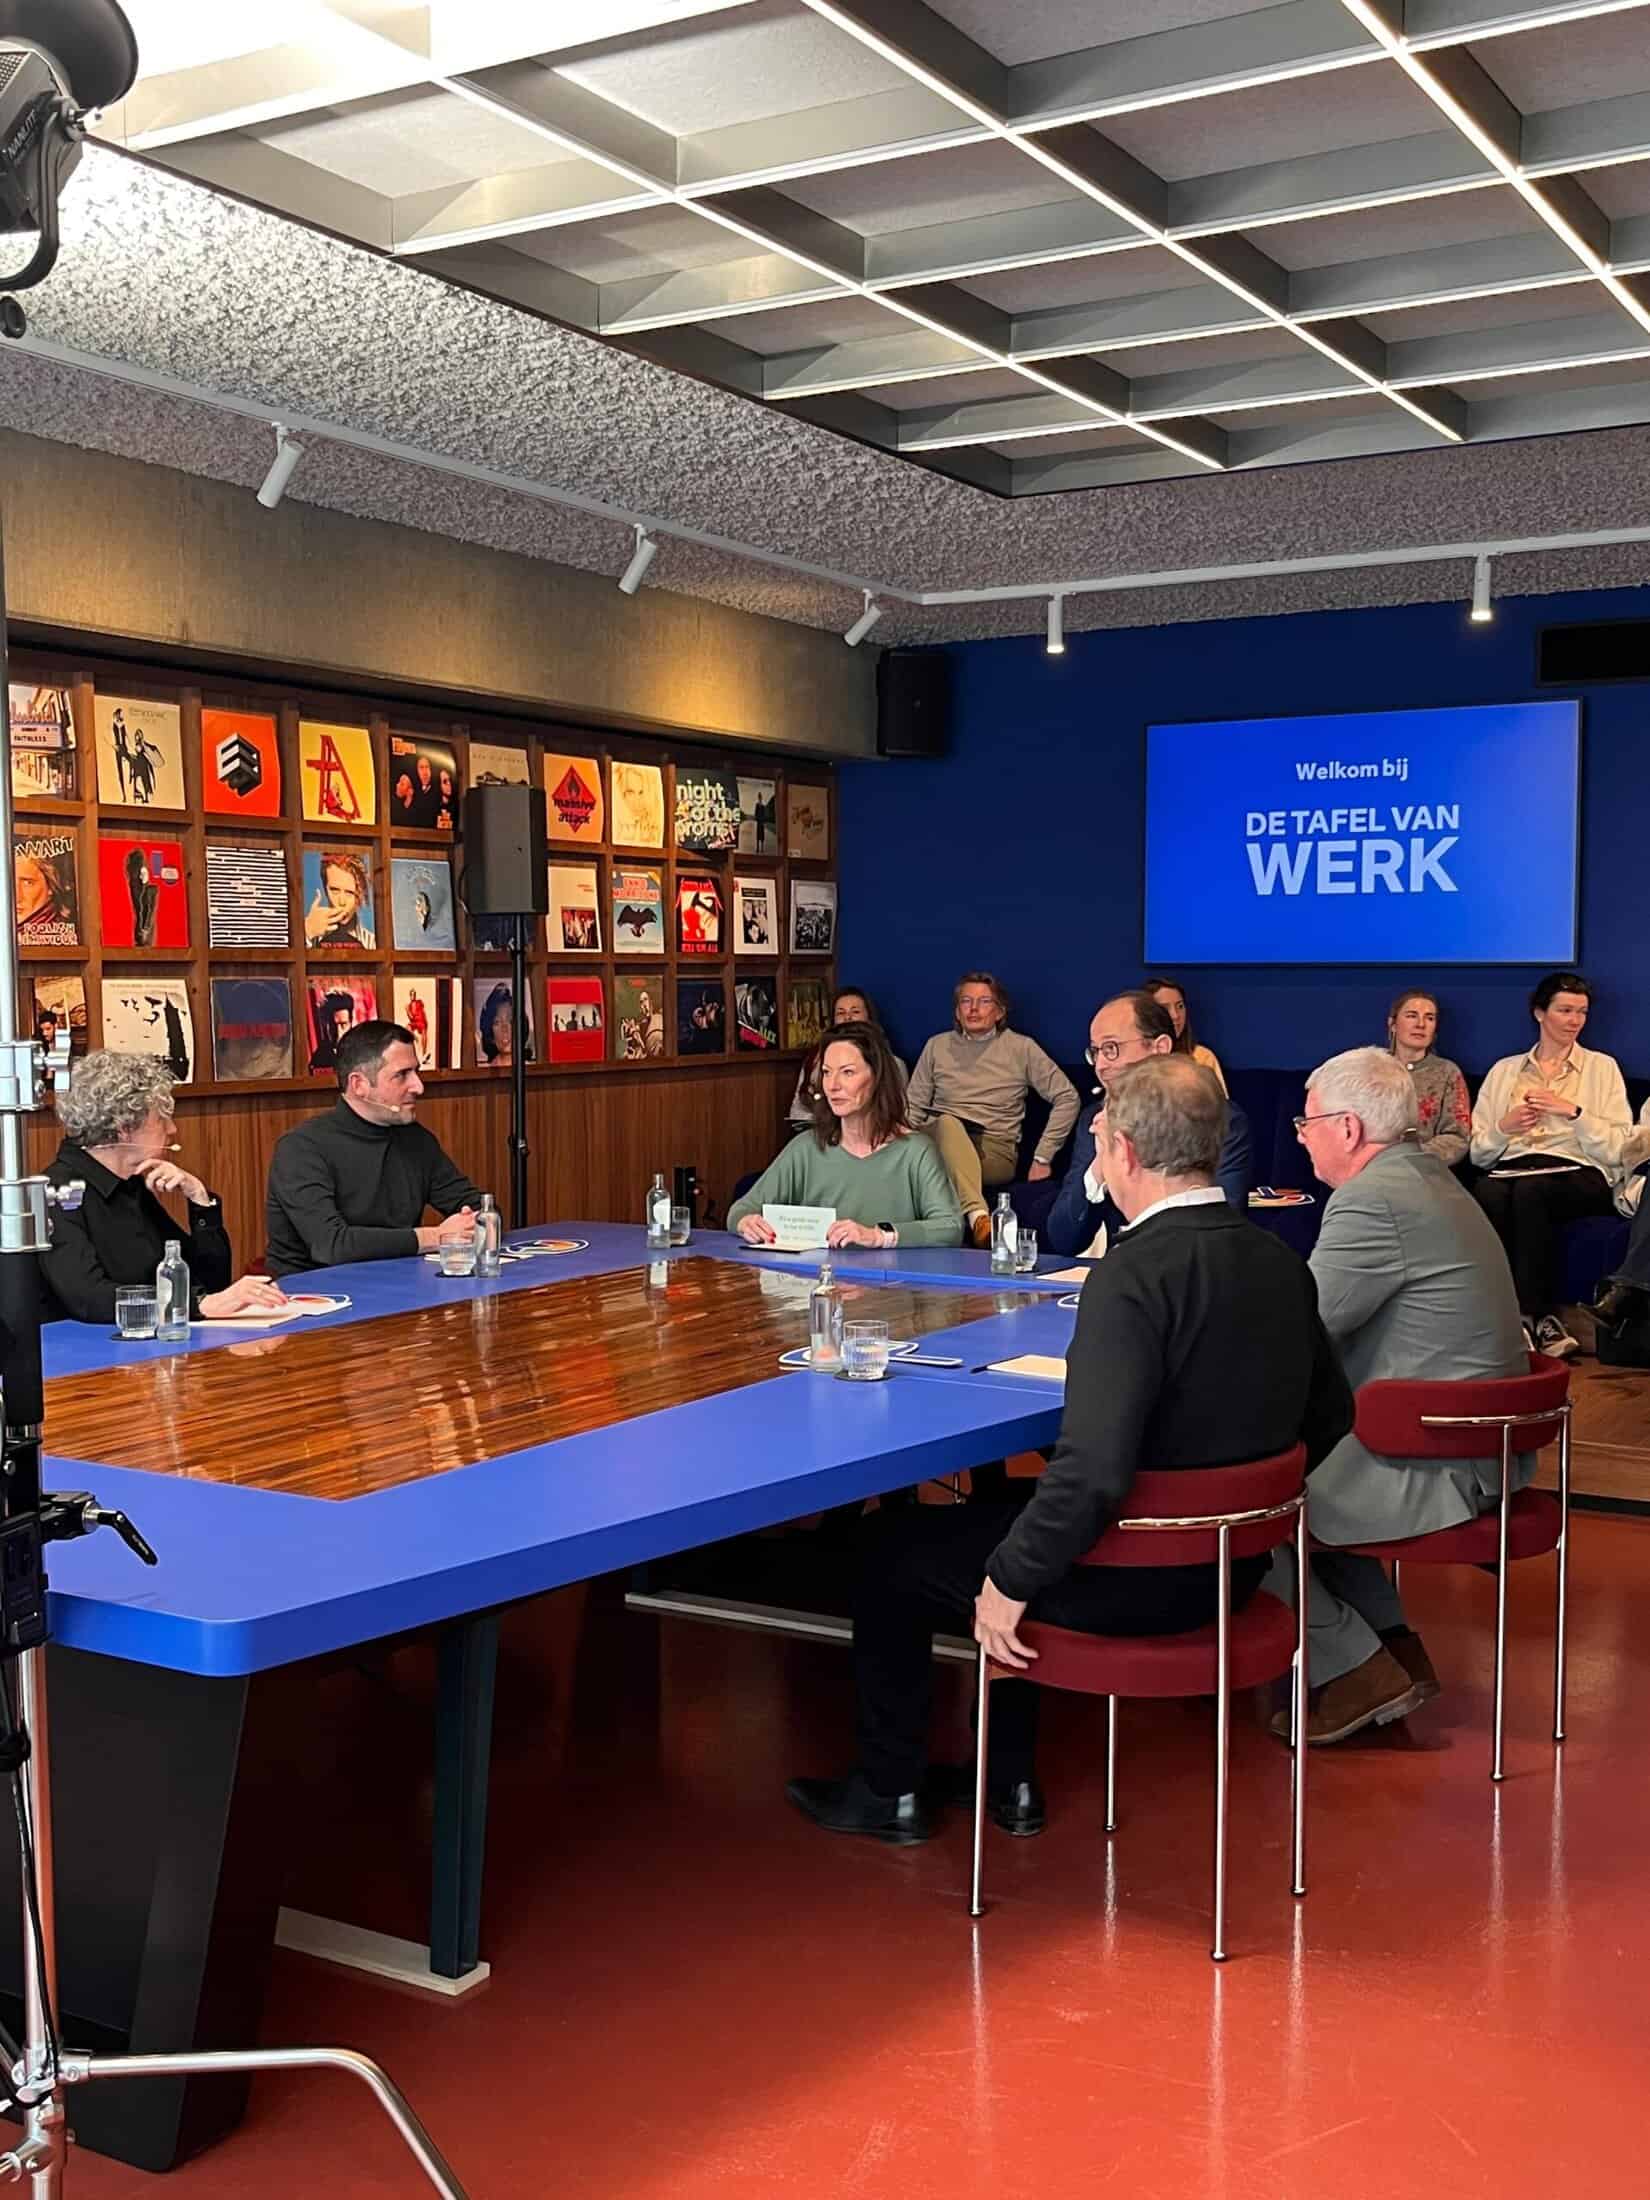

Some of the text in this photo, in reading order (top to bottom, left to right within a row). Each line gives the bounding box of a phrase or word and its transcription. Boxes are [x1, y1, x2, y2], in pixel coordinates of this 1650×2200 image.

[1296, 758, 1408, 781] Welkom bij
[676, 779, 725, 806] night
[1246, 805, 1459, 836] DE TAFEL VAN
[1246, 837, 1459, 895] WERK
